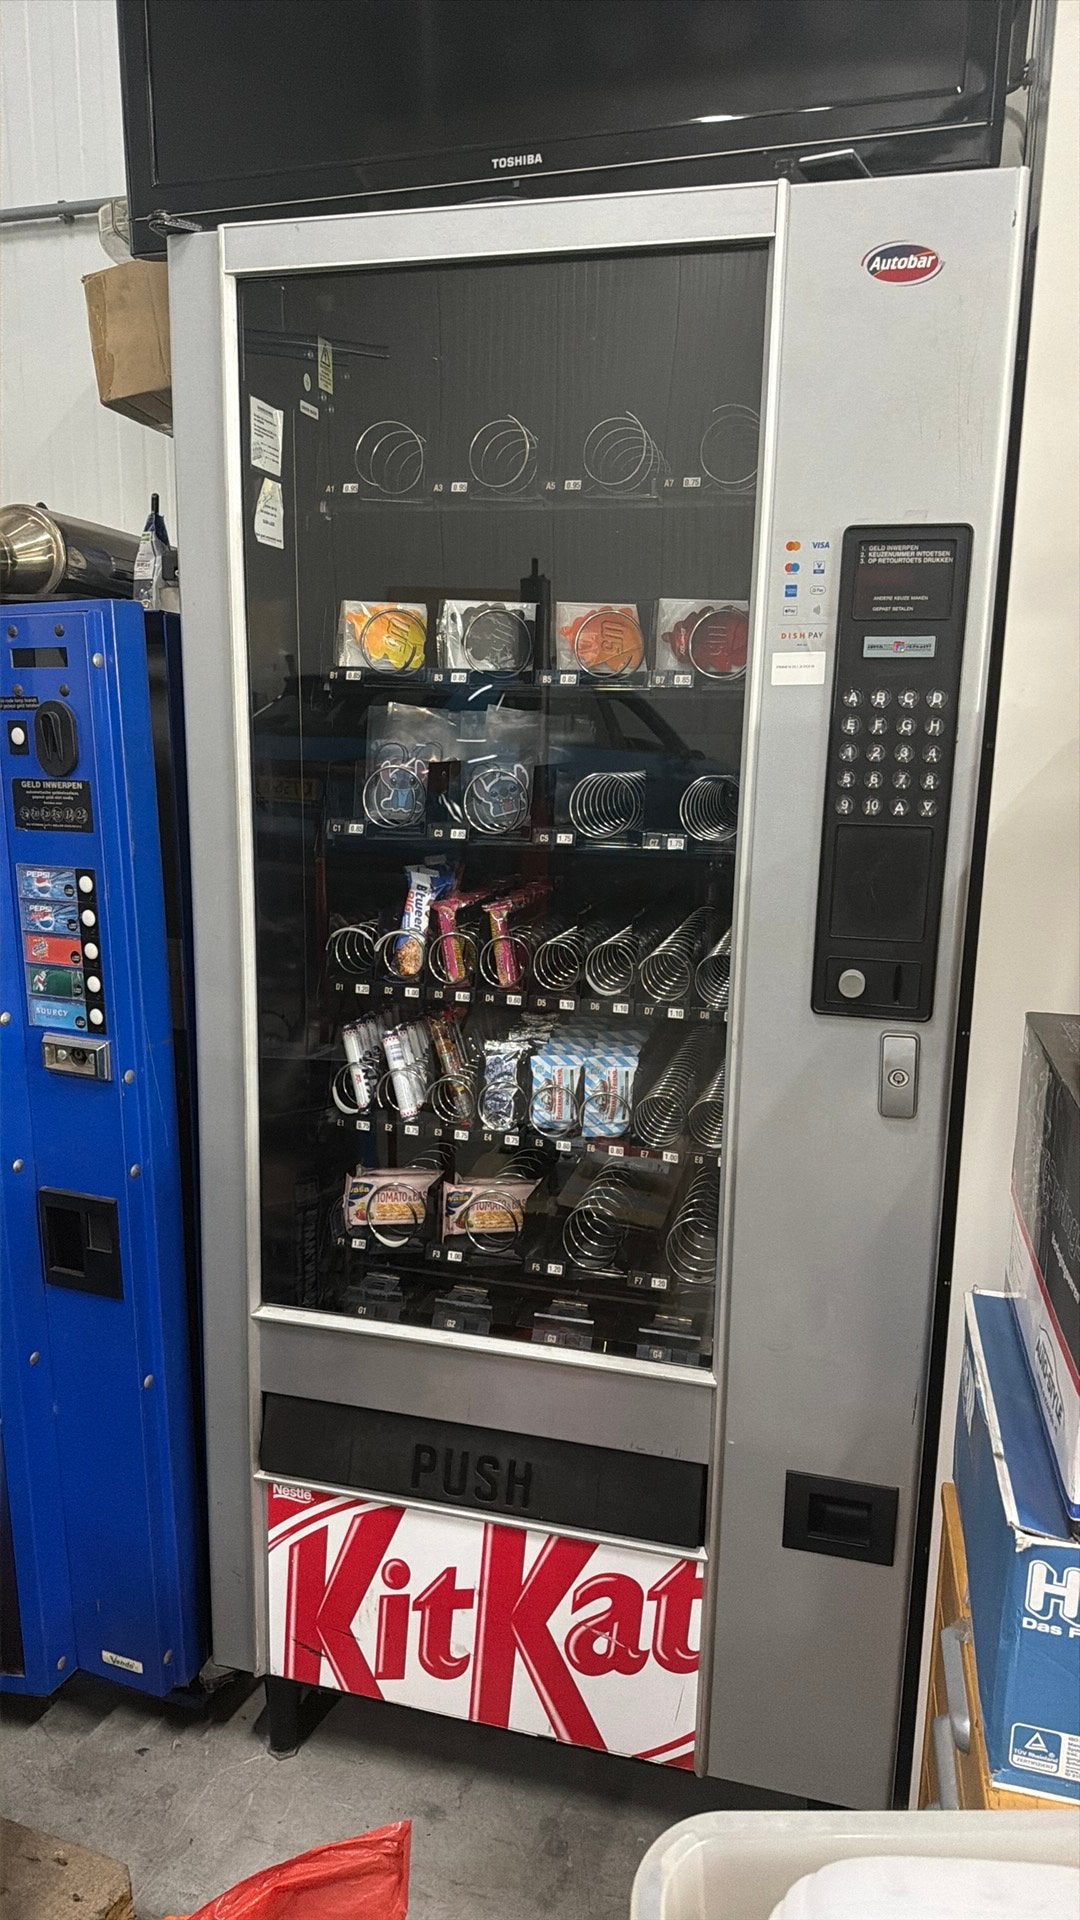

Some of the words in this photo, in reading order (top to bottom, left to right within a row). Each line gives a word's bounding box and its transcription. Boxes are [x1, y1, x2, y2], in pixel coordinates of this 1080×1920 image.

[491, 153, 543, 169] TOSHIBA
[869, 254, 936, 271] Autobar
[433, 484, 443, 492] A3
[545, 482, 556, 490] A5
[664, 479, 674, 488] A7
[684, 479, 700, 487] 0.75
[325, 485, 335, 493] A1
[781, 632, 806, 640] DISH
[434, 674, 444, 682] B3
[562, 675, 576, 683] 0.85
[655, 676, 666, 684] B7
[676, 676, 691, 684] 0.85
[848, 692, 858, 703] A
[876, 692, 886, 702] B
[904, 692, 914, 702] C
[933, 693, 943, 703] D
[847, 719, 855, 730] E
[874, 719, 883, 730] F
[901, 720, 912, 731] G
[930, 720, 940, 731] H
[846, 747, 852, 758] 1
[872, 747, 881, 757] 2
[901, 747, 909, 758] 3
[928, 748, 936, 758] 4
[843, 773, 851, 783] 5
[870, 773, 878, 783] 6
[898, 774, 906, 784] 7
[926, 775, 934, 785] 8
[21, 781, 41, 789] GELD
[43, 781, 83, 790] INWERPEN
[841, 800, 849, 810] 9
[866, 800, 879, 810] 10
[539, 834, 549, 842] C5
[669, 839, 683, 848] 1.75
[26, 870, 50, 879] PEPSI
[29, 904, 53, 913] PEPSI
[336, 983, 344, 991] D1
[384, 987, 393, 995] D2
[485, 994, 495, 1002] D4
[537, 999, 547, 1007] D5
[561, 1001, 574, 1009] 1.10
[590, 1002, 600, 1011] D6
[614, 1005, 628, 1013] 1.10
[36, 1007, 69, 1017] SOURCY
[644, 1007, 654, 1016] D7
[669, 1010, 684, 1018] 1.10
[700, 1011, 710, 1020] D8
[336, 1119, 344, 1127] E1
[357, 1122, 370, 1130] 0.75
[384, 1123, 393, 1132] E2
[455, 1131, 468, 1140] 0.75
[483, 1134, 493, 1142] E4
[505, 1136, 519, 1145] 0.75
[535, 1139, 544, 1147] E5
[587, 1144, 596, 1152] E6
[641, 1150, 649, 1158] E7
[664, 1153, 678, 1162] 1.00
[694, 1156, 704, 1165] E8
[377, 1191, 408, 1202] TOMATO
[337, 1238, 345, 1246] F1
[353, 1240, 366, 1248] 1.00
[432, 1250, 441, 1258] F3
[449, 1253, 462, 1261] 1.00
[532, 1263, 541, 1271] F5
[549, 1265, 562, 1273] 1.20
[634, 1277, 643, 1285] F7
[652, 1279, 666, 1288] 1.20
[358, 1306, 367, 1315] G1
[446, 1319, 456, 1328] G2
[652, 1351, 662, 1359] G4
[410, 1443, 533, 1508] PUSH
[284, 1504, 703, 1751] KitKat
[1022, 1616, 1063, 1636] Das
[1014, 1748, 1028, 1756] TÜV
